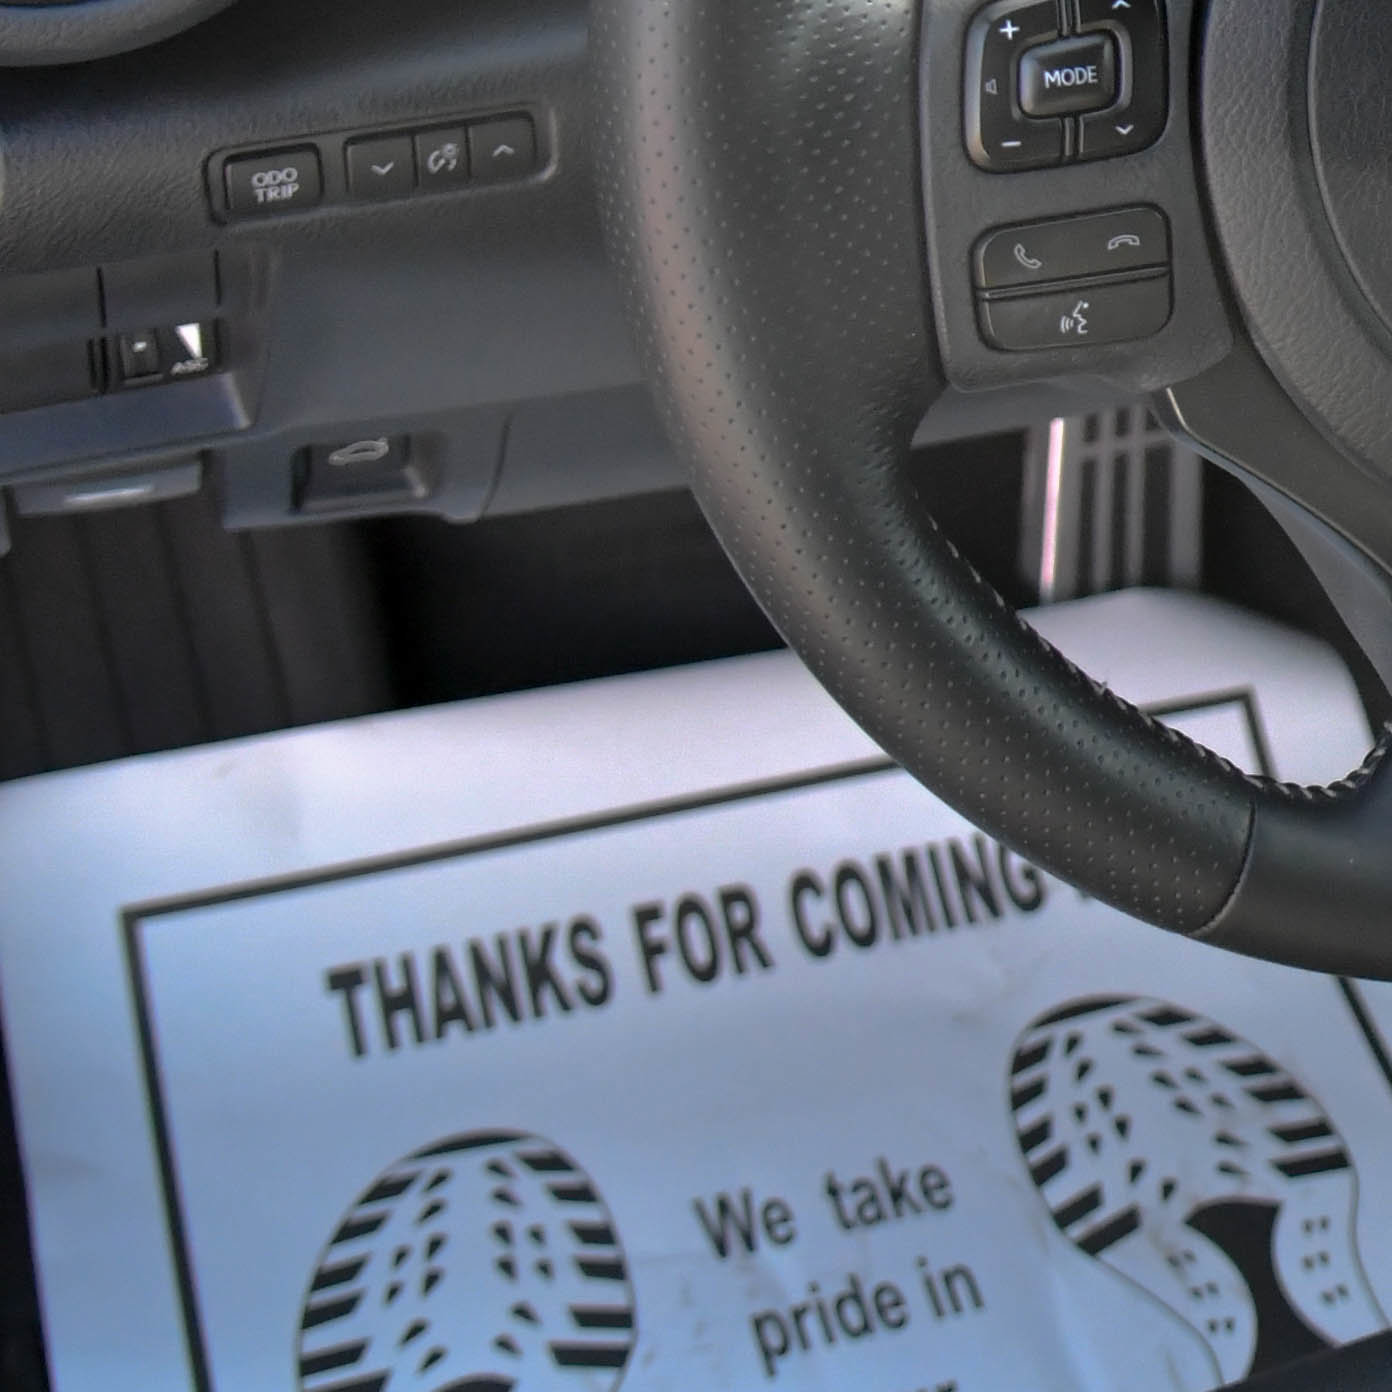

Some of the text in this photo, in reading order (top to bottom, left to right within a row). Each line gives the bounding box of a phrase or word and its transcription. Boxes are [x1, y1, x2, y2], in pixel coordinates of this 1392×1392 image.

[1044, 65, 1098, 89] MODE
[252, 167, 298, 188] ODO
[255, 183, 299, 204] TRIP
[326, 830, 1048, 1057] THANKS FOR COMING
[692, 1155, 955, 1259] We take
[750, 1255, 986, 1378] pride in
